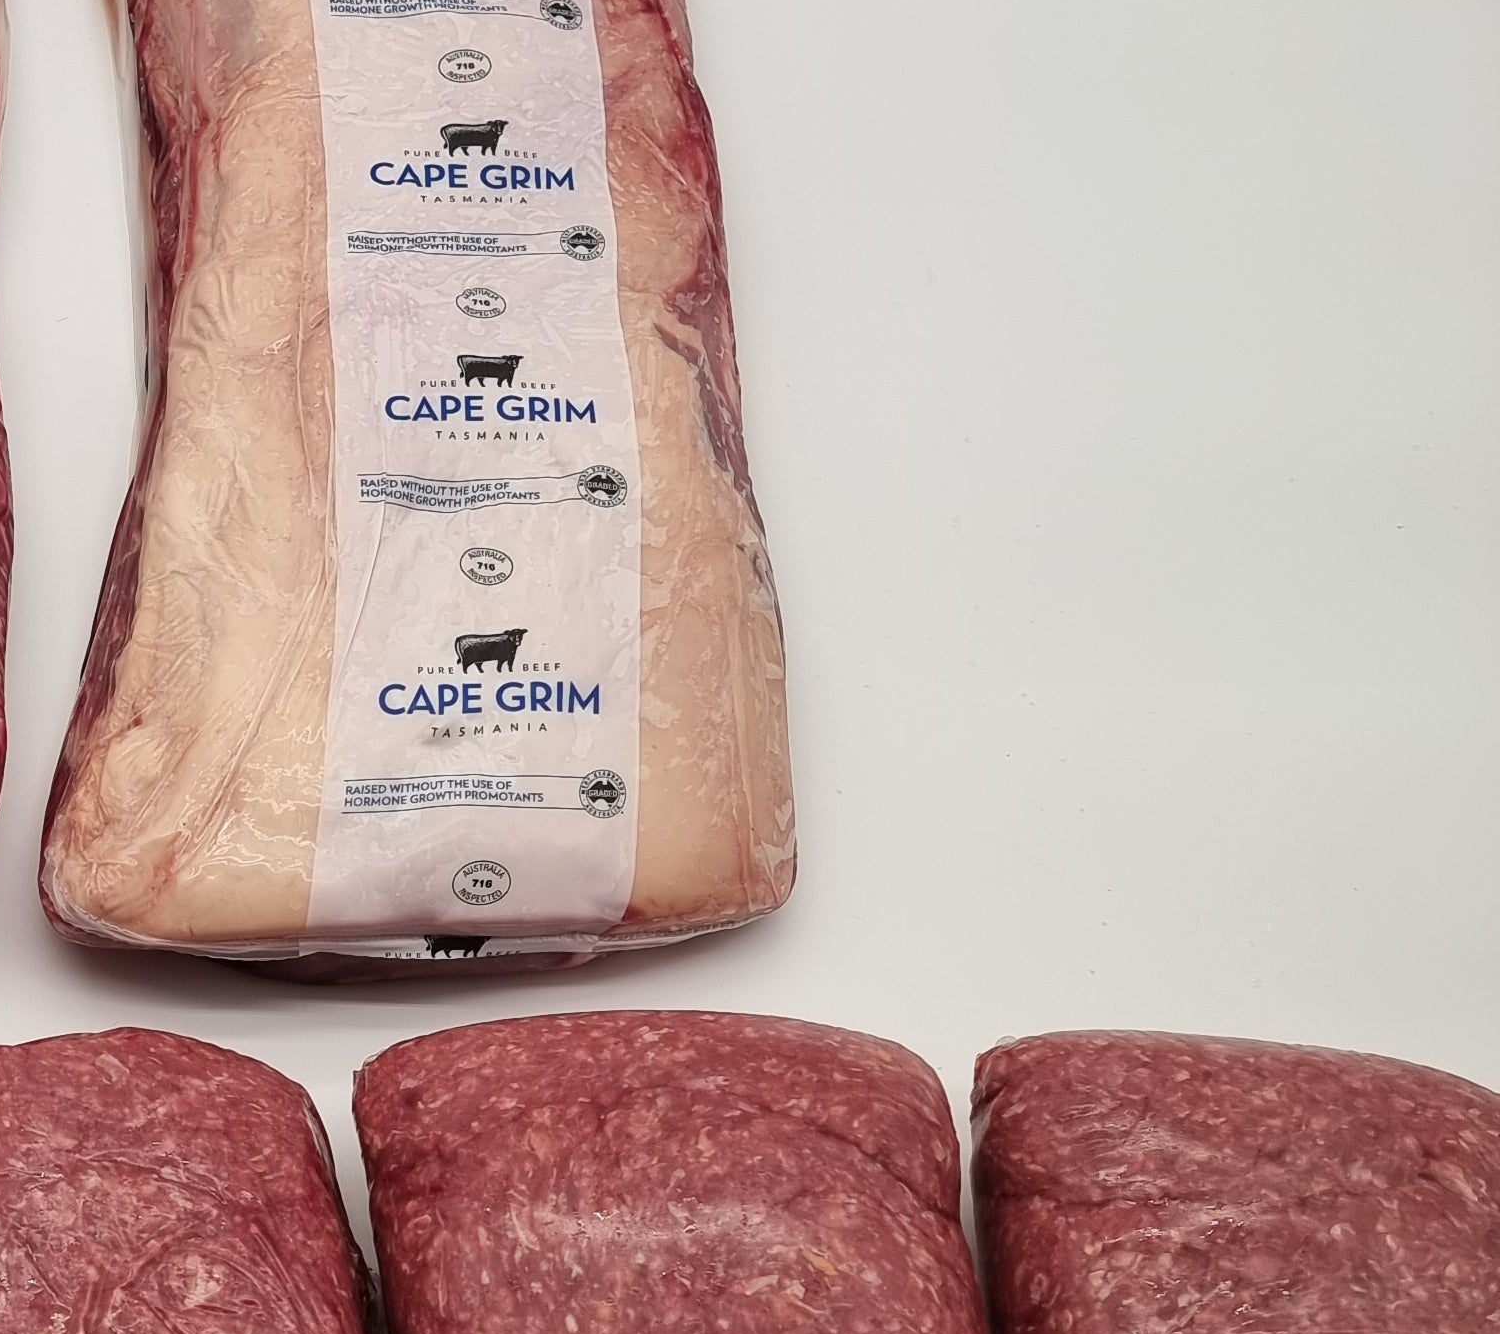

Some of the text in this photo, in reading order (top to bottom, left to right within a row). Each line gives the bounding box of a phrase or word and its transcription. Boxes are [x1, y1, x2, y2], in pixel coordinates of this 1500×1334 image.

[330, 2, 508, 14] HORMONE GROWTH PROMOTANTS
[403, 149, 538, 159] PURE BEEF
[370, 162, 575, 191] CAPE GRIM
[420, 195, 528, 204] TASMANIA
[347, 235, 499, 245] RAISED WITHOUT THE USE OF
[456, 244, 527, 253] PROMOTANTS
[420, 380, 556, 390] PURE BEEF
[385, 395, 596, 423] CAPE GRIM
[436, 430, 545, 441] TASMANIA
[360, 477, 510, 496] RAISED WITHOUT THE USE OF
[361, 488, 540, 508] HORMONE GROWTH PROMOTANTS
[522, 663, 561, 672] BEEF
[379, 681, 600, 715] CAPE GRIM
[430, 722, 547, 738] TASMANIA
[345, 779, 512, 796] RAISED WITHOUT THE USE OF
[344, 791, 544, 807] HORMONE GROWTH PROMOTANTS
[463, 863, 505, 879] AUSTRALIA
[457, 888, 503, 904] INSPECTED
